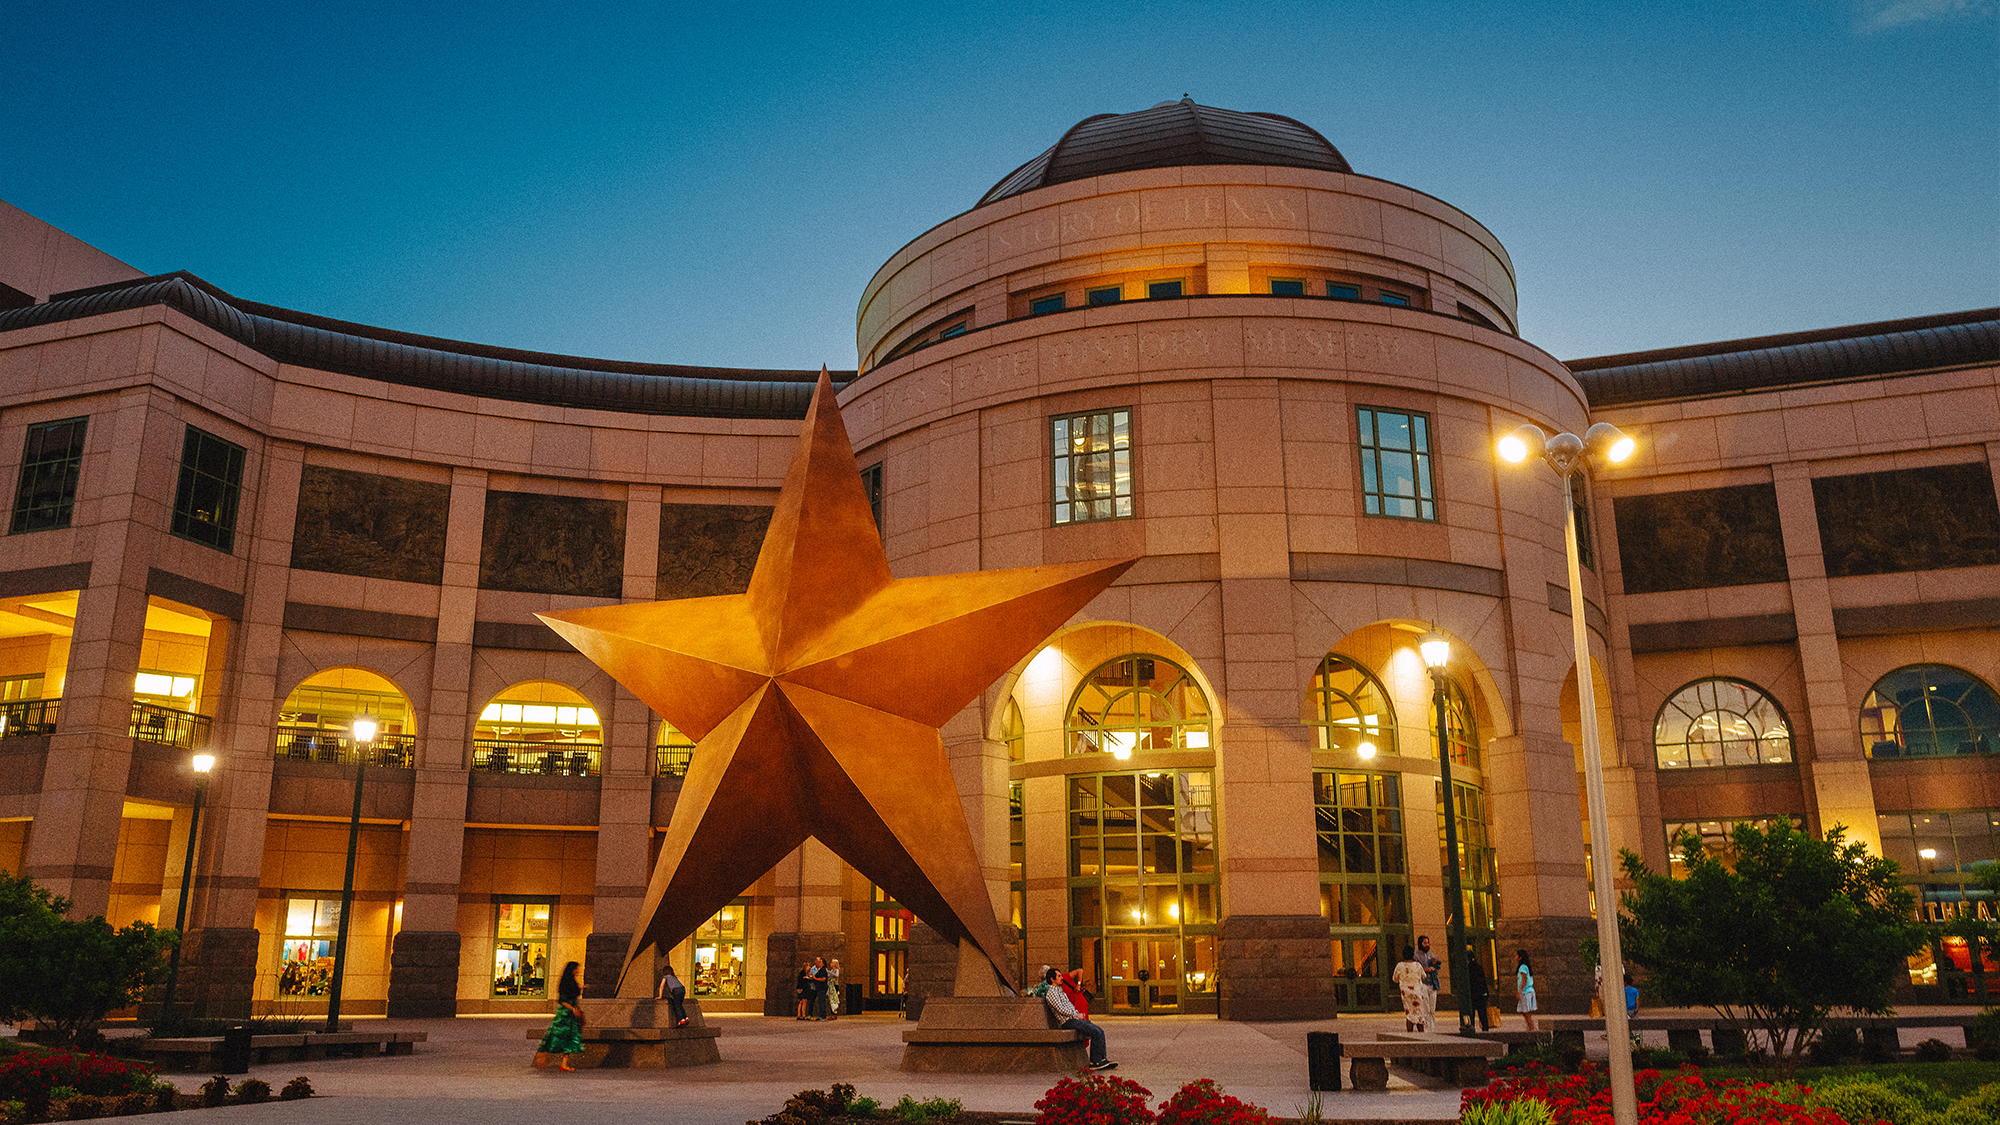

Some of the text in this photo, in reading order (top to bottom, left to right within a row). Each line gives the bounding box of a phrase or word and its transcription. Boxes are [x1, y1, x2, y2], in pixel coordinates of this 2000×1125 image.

[999, 210, 1099, 254] STORY
[1115, 199, 1160, 225] OF
[1178, 196, 1296, 223] TEXAS
[858, 327, 1403, 427] TEXAS STATE HISTORY MUSEUM
